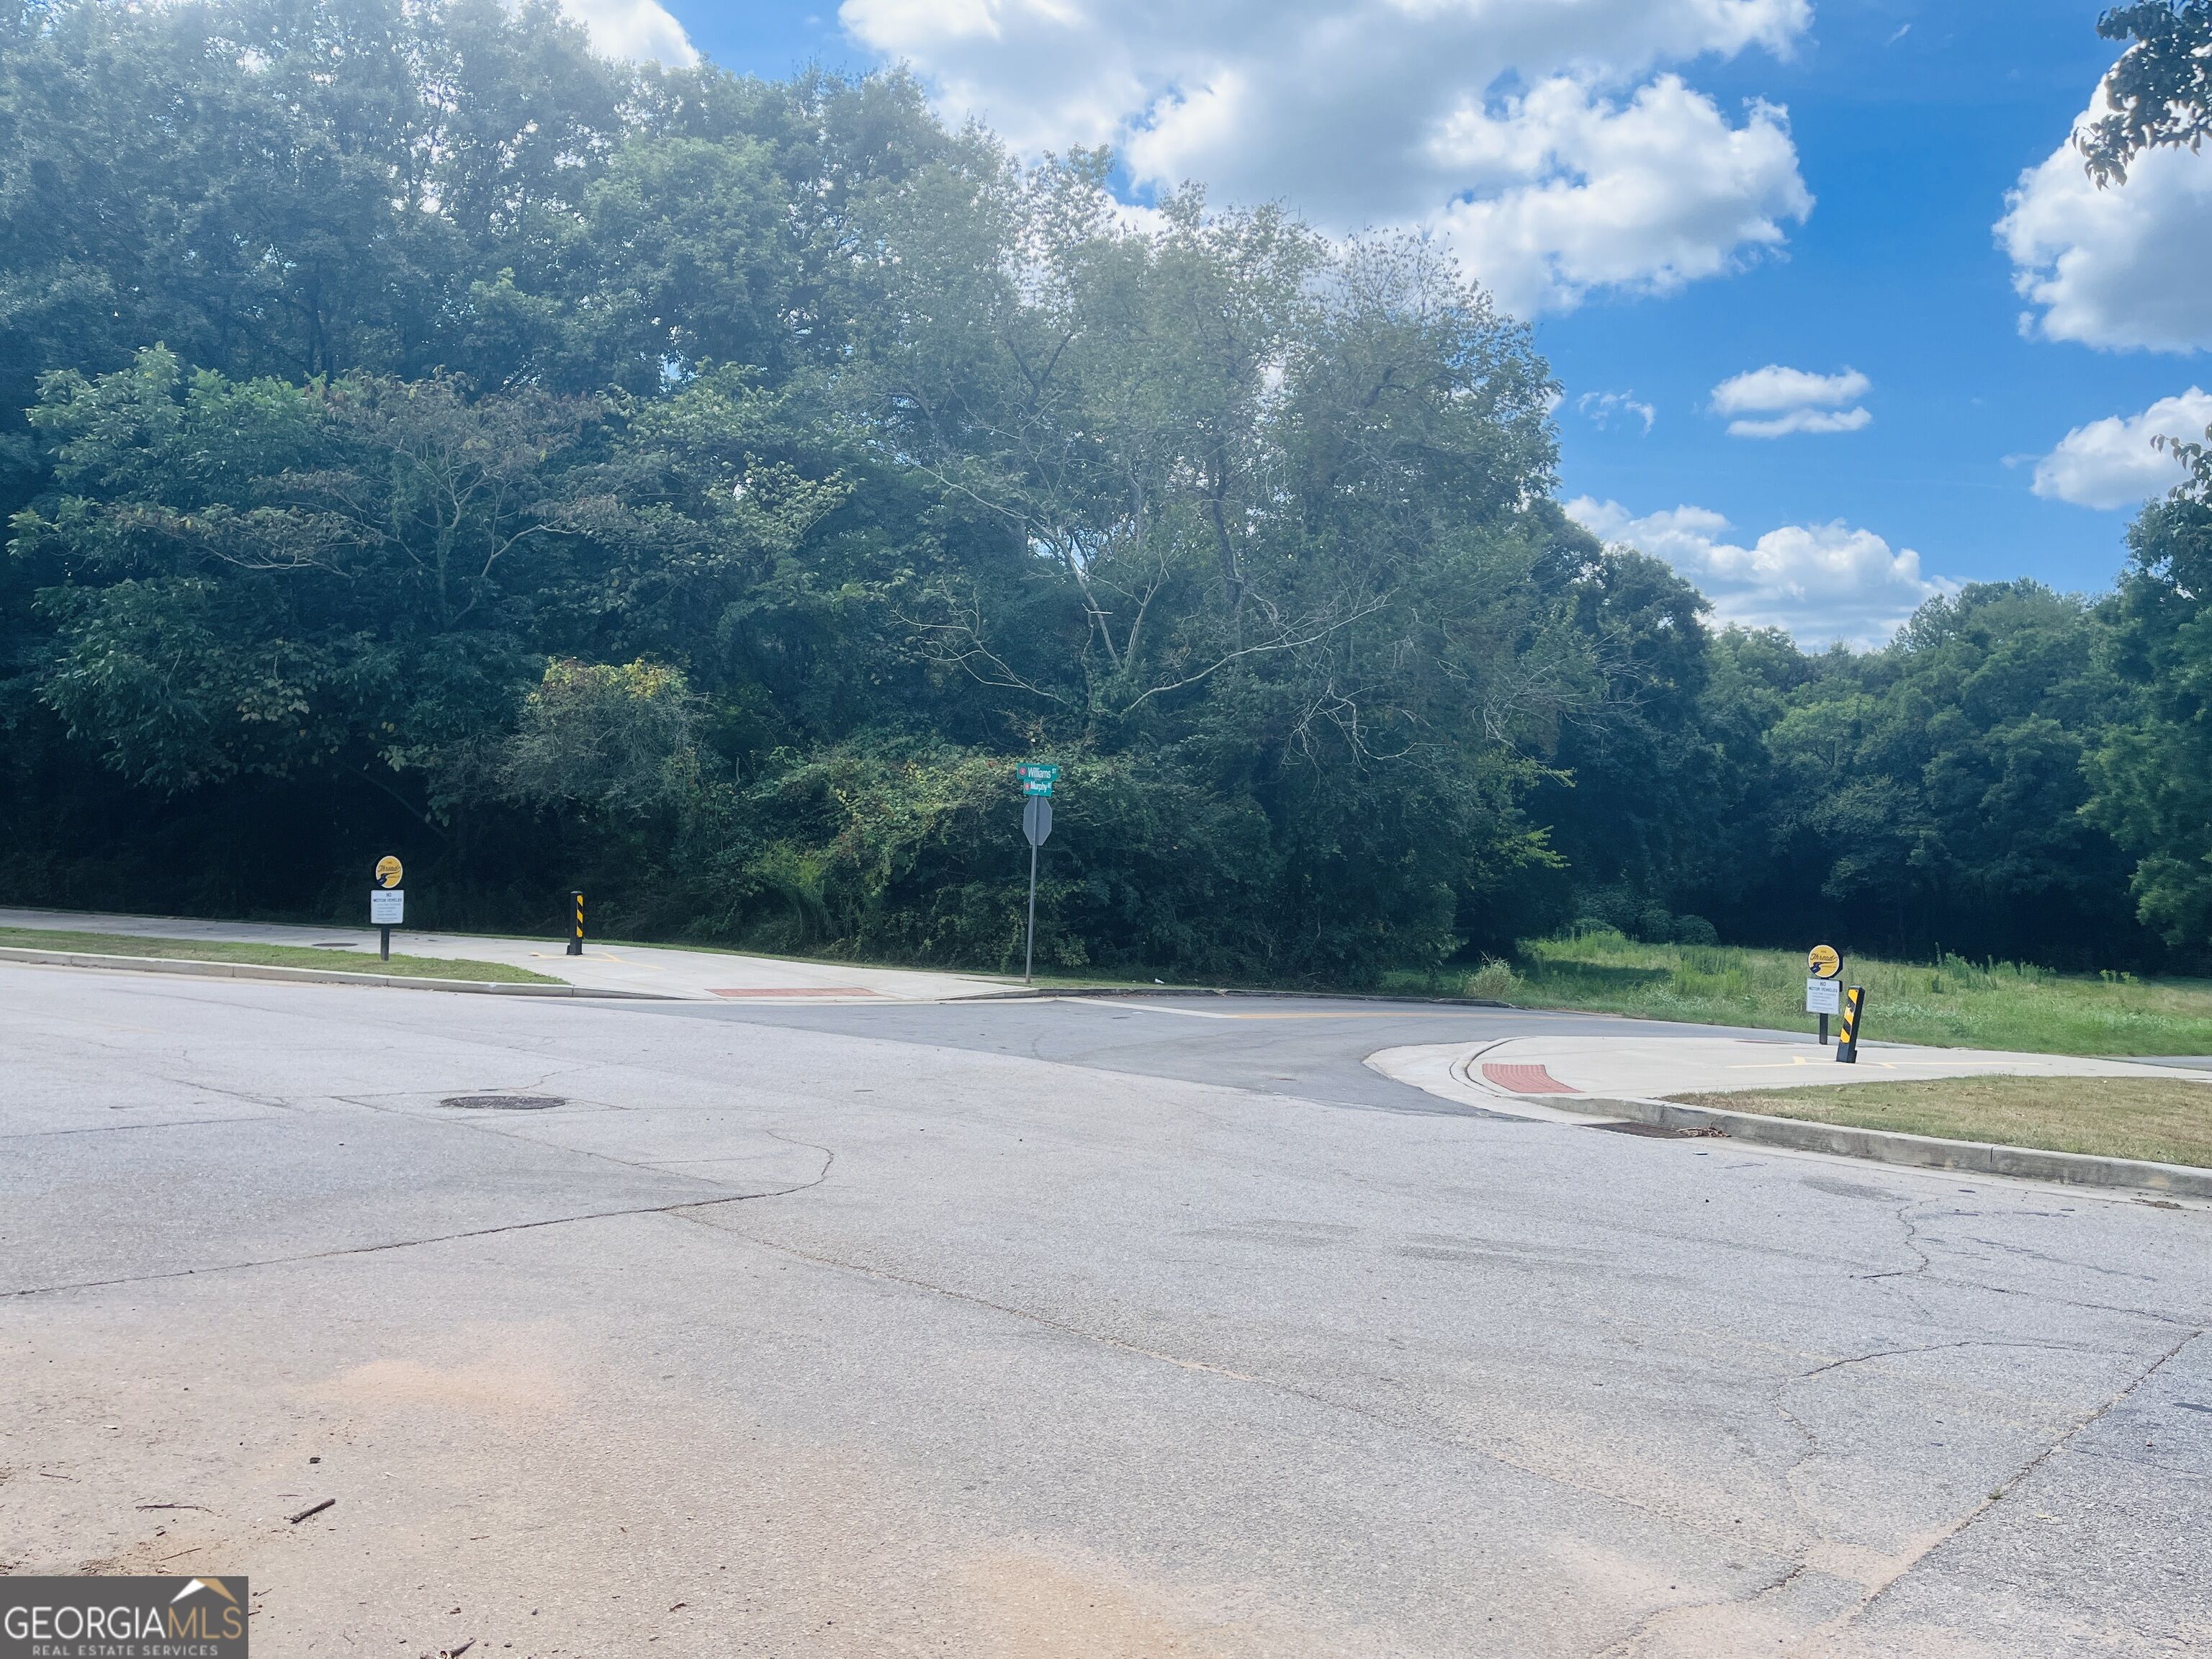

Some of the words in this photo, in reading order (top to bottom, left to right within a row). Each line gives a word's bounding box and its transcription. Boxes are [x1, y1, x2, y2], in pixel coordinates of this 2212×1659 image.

[1028, 767, 1051, 778] Williams
[1030, 781, 1047, 793] Murphy
[1810, 953, 1835, 961] Thread
